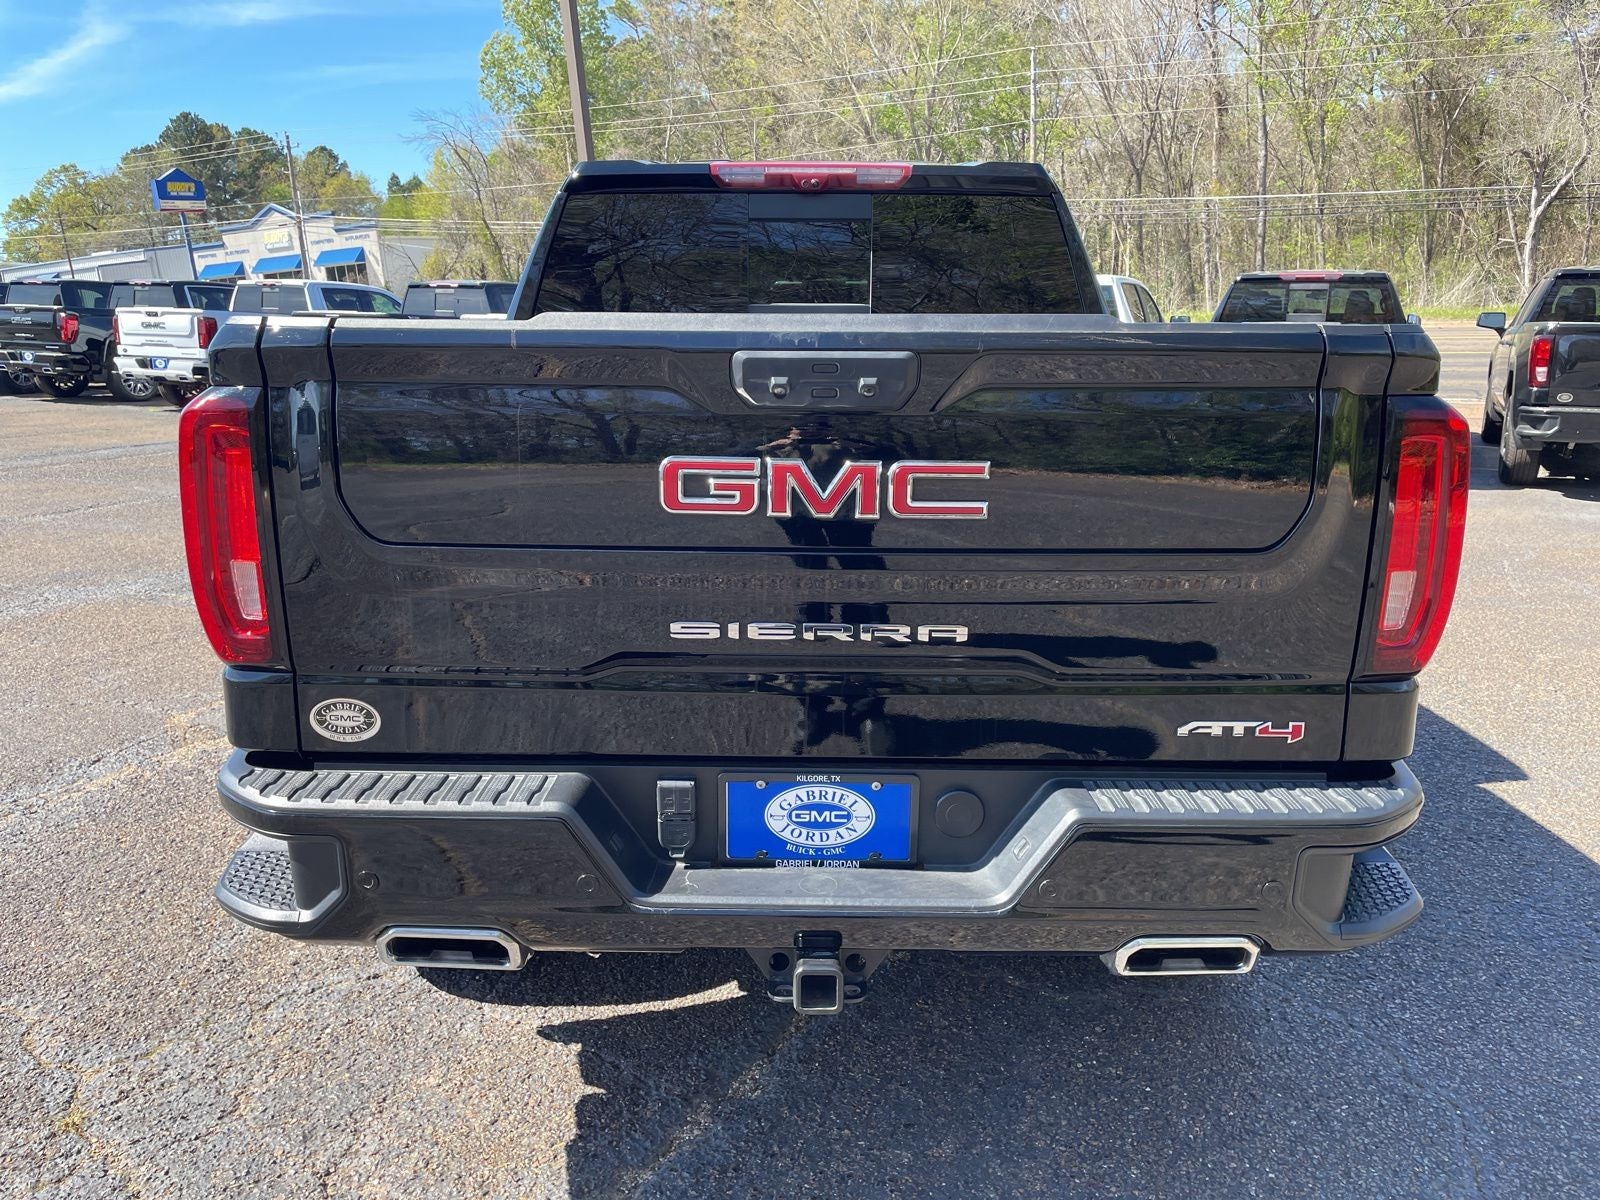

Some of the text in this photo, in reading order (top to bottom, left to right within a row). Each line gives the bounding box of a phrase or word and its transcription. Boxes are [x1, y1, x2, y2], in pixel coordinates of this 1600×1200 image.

[659, 455, 991, 520] GMC
[669, 621, 969, 643] SIERRA
[321, 703, 368, 717] GABRIEL
[329, 714, 361, 722] GMC
[320, 721, 368, 734] JORDAN
[1177, 721, 1306, 744] AT4
[831, 775, 841, 783] TX
[778, 788, 858, 813] GABRIEL
[791, 810, 848, 823] GMC
[778, 822, 859, 843] JORDAN
[785, 843, 816, 856] BUICK
[823, 846, 847, 856] GMC
[775, 859, 815, 868] GABRIEL
[822, 860, 860, 869] JORDAN
